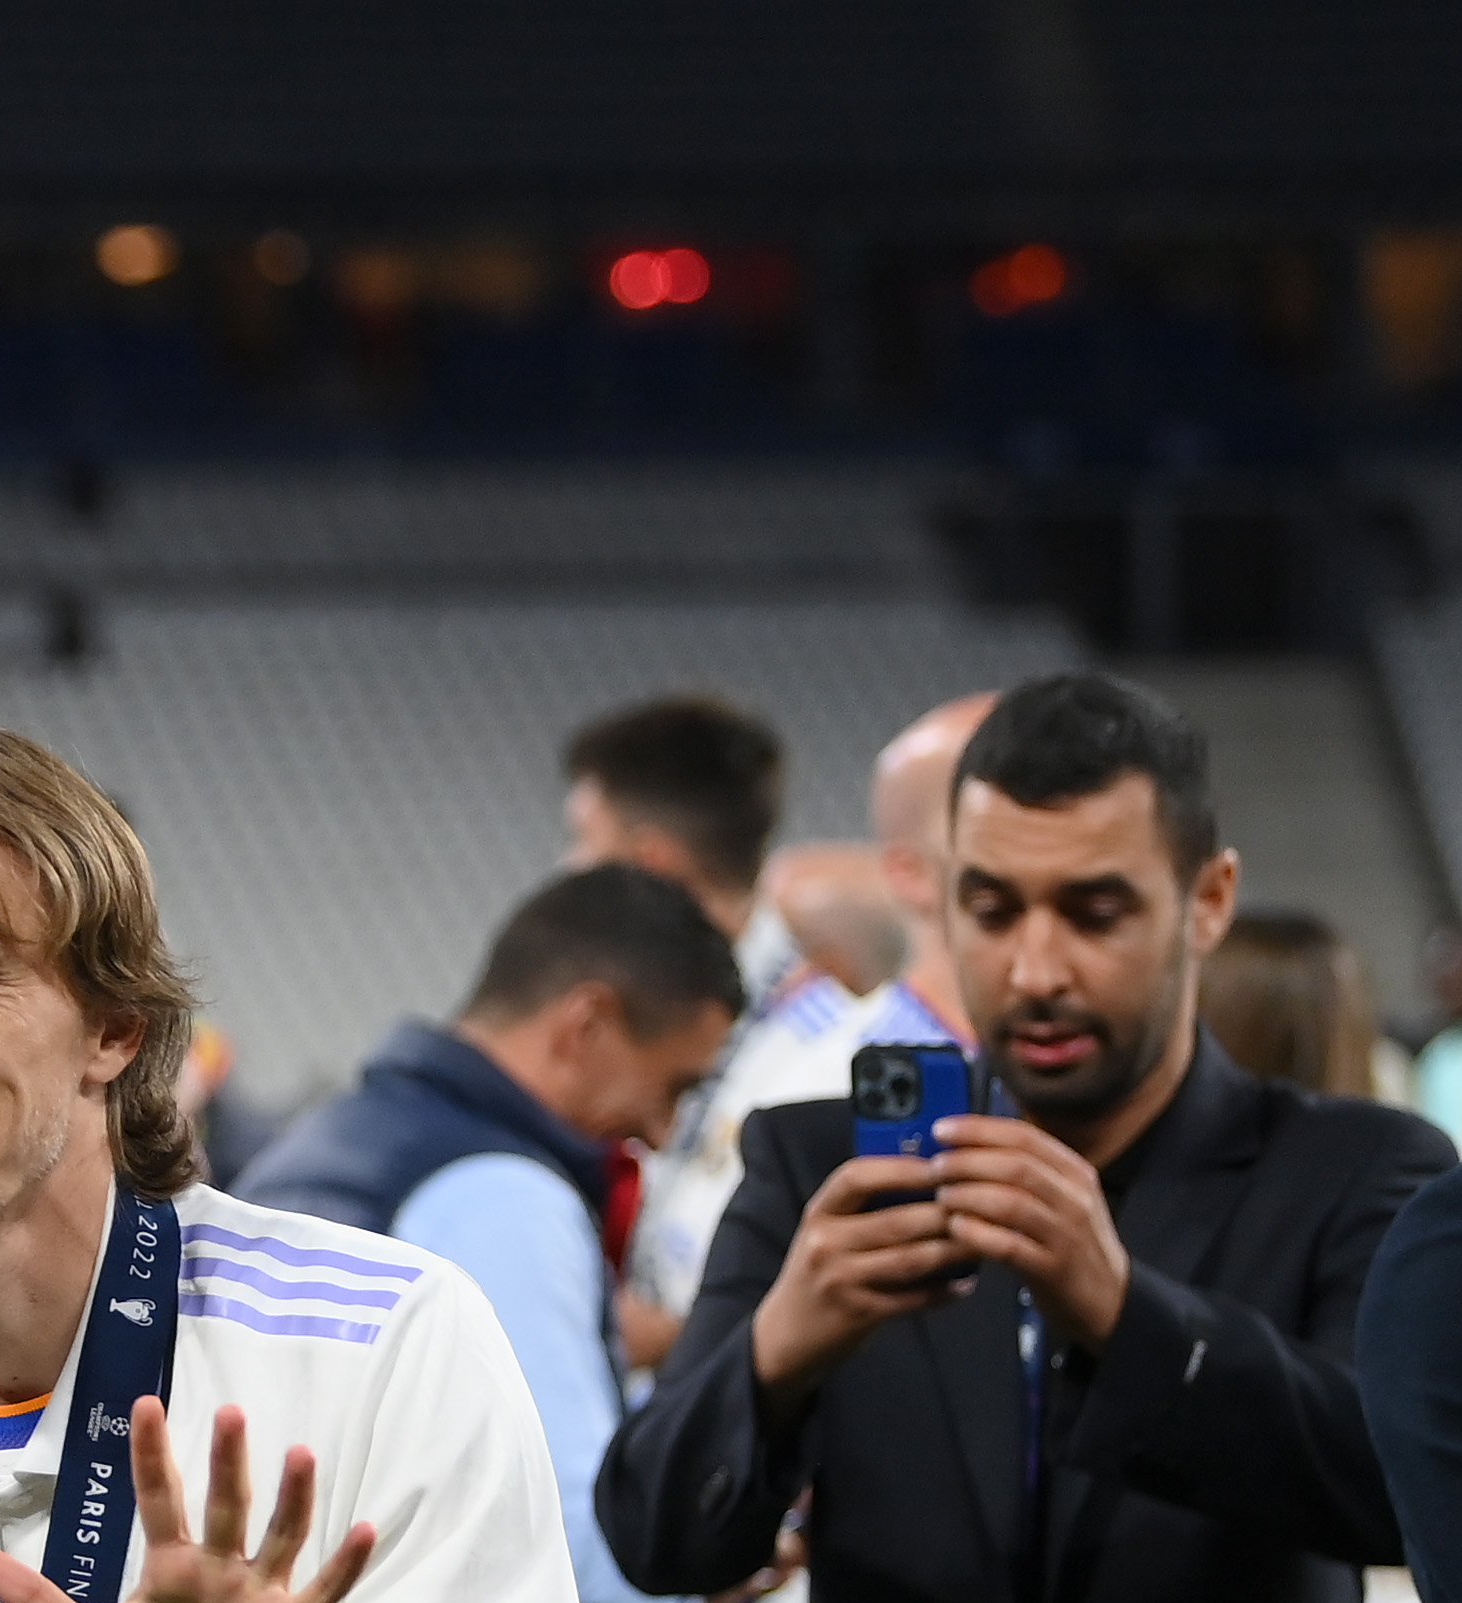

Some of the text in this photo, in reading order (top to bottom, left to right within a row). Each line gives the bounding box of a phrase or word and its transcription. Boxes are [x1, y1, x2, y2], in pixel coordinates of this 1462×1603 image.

[129, 1215, 158, 1279] 2022
[76, 1461, 113, 1545] PARIS
[66, 1554, 95, 1598] FIN
